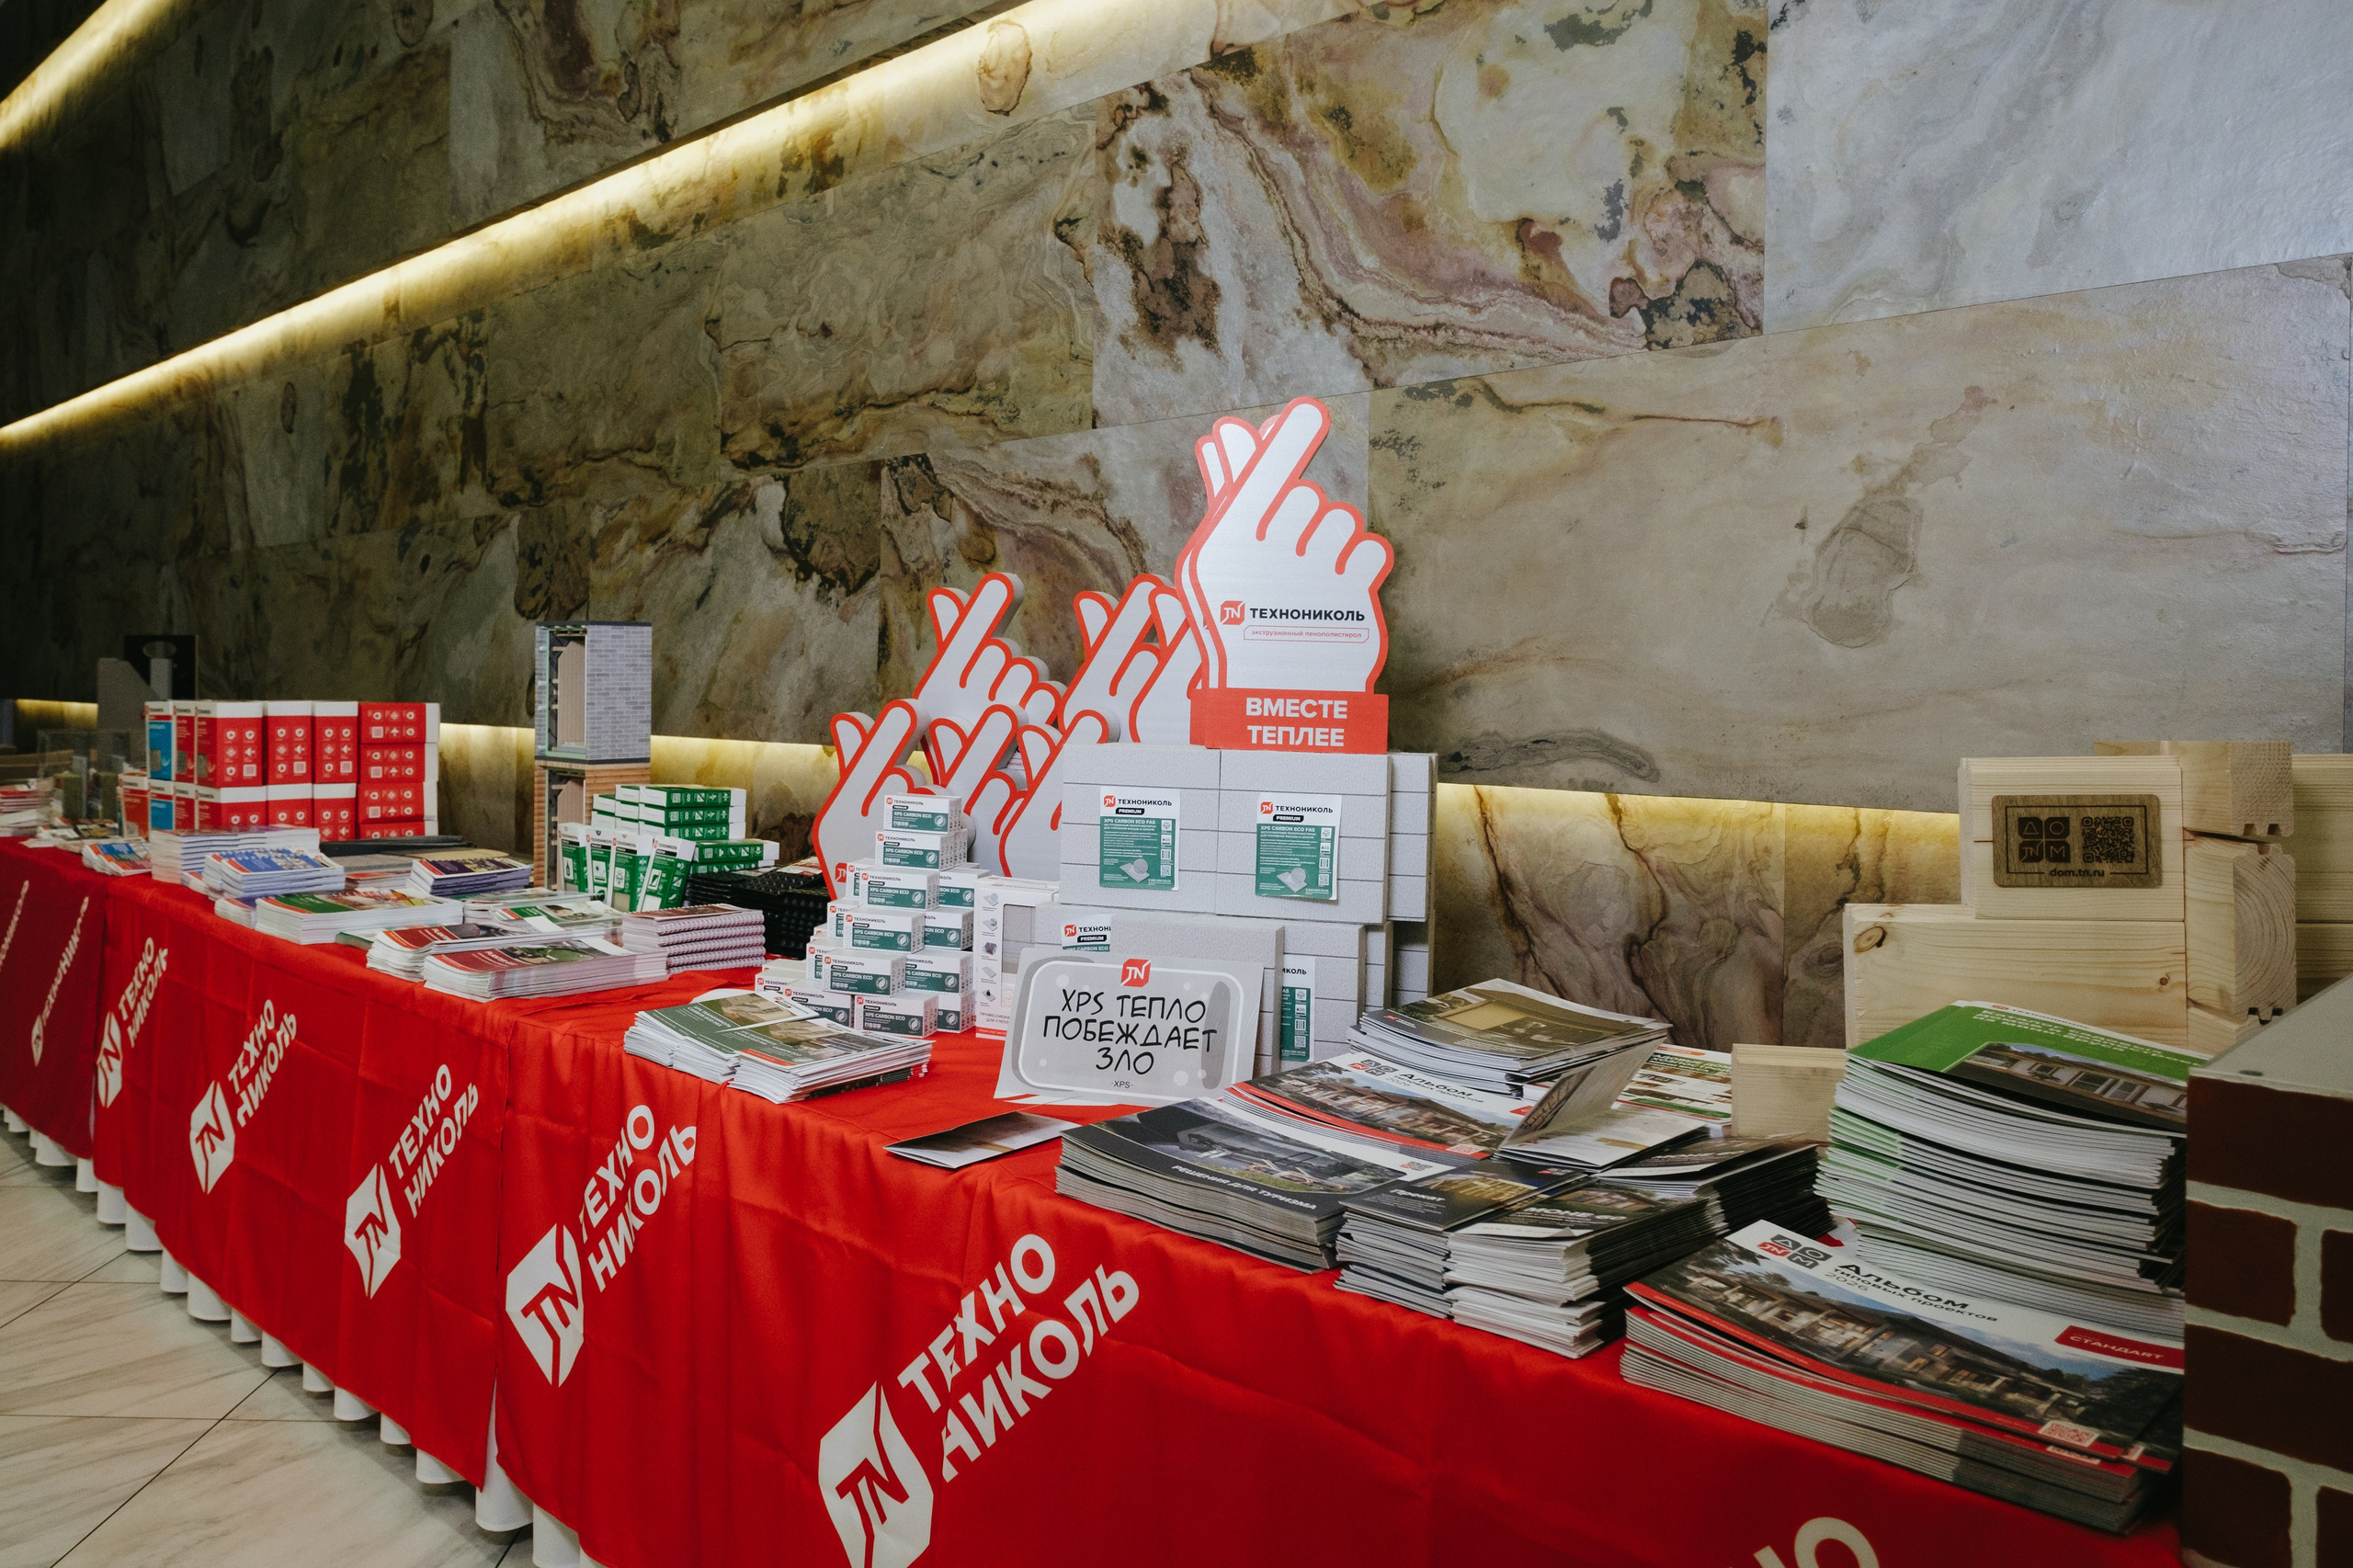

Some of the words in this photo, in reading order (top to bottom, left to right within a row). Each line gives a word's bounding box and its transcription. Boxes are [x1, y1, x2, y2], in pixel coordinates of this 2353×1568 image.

[1250, 608, 1365, 621] ТЕХНОНИКОЛЬ
[1251, 630, 1304, 638] экструзионный
[1304, 631, 1362, 639] пенополистирол
[1245, 697, 1347, 720] ВМЕСТЕ
[1247, 725, 1345, 747] ТЕПЛЕЕ
[1276, 805, 1334, 813] ТЕХНОНИКОЛЬ
[2049, 868, 2105, 878] dom.tn.ru
[119, 937, 154, 1020] ТЕХНО
[1062, 988, 1105, 1016] XPS
[1116, 994, 1206, 1024] ТЕПЛО
[228, 999, 275, 1095] ТЕХНО
[1043, 1015, 1218, 1052] ПОБЕЖДАЕТ
[1096, 1047, 1154, 1075] ЗЛО
[1393, 1075, 1434, 1091] типовых
[1435, 1088, 1484, 1104] проектов
[1399, 1073, 1474, 1098] Альбом
[389, 1063, 452, 1179] ТЕХНО
[404, 1083, 479, 1219] НИКОЛЬ
[587, 1124, 697, 1293] НИКОЛЬ
[1824, 1272, 1869, 1291] 2026
[1834, 1267, 1905, 1299] типовых
[1910, 1297, 1998, 1322] проектов
[1838, 1264, 1970, 1310] Альбом
[896, 1233, 1056, 1414] ТЕХНО
